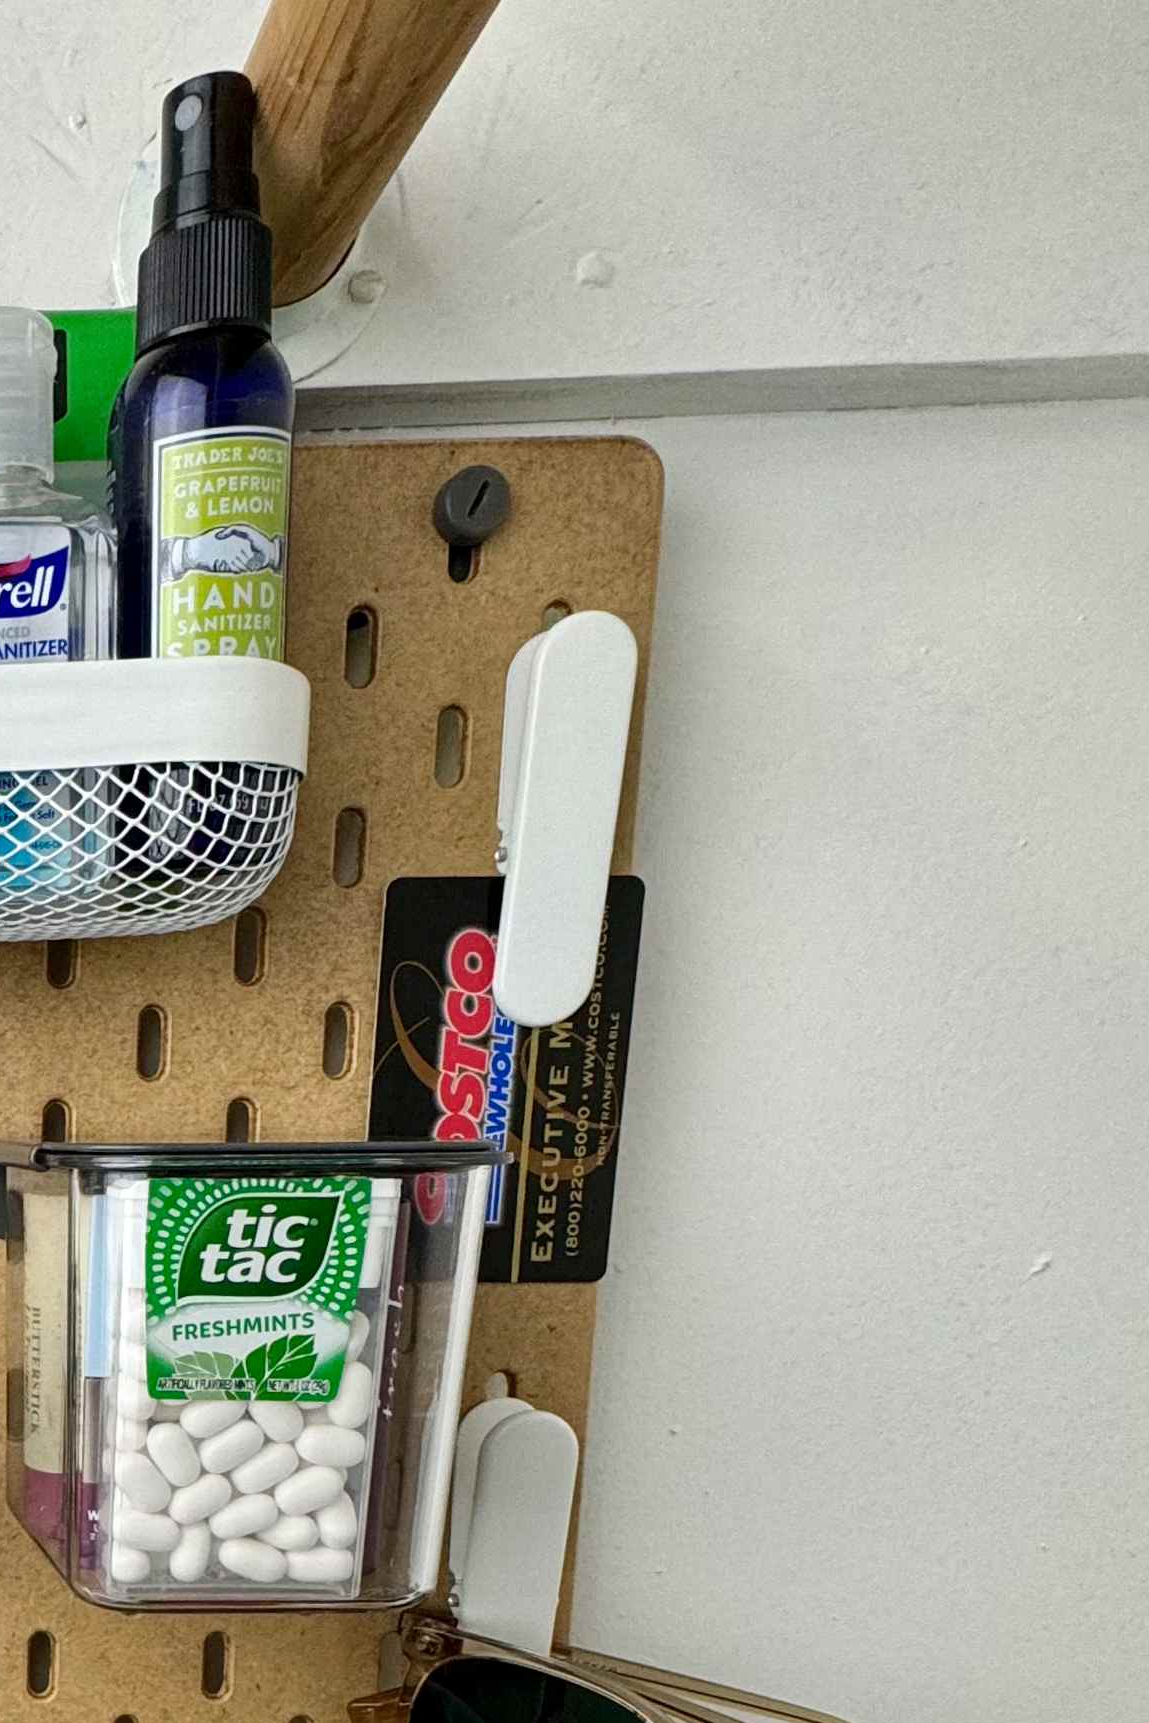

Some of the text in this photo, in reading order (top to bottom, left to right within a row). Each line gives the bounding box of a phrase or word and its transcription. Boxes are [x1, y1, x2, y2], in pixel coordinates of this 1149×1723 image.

[172, 447, 242, 469] TRADER
[174, 475, 281, 499] GRAPEFRUIT
[185, 497, 274, 519] & LEMON
[172, 581, 276, 616] HAND
[177, 614, 271, 637] SANITIZER
[582, 905, 612, 1088] WWW.COSTCO.CO
[596, 1011, 621, 1166] NON-TRANSFERABLE
[530, 1064, 570, 1263] EXECUTIVE
[226, 1203, 310, 1249] tic
[199, 1243, 302, 1284] tac
[172, 1311, 315, 1341] FRESHMINTS
